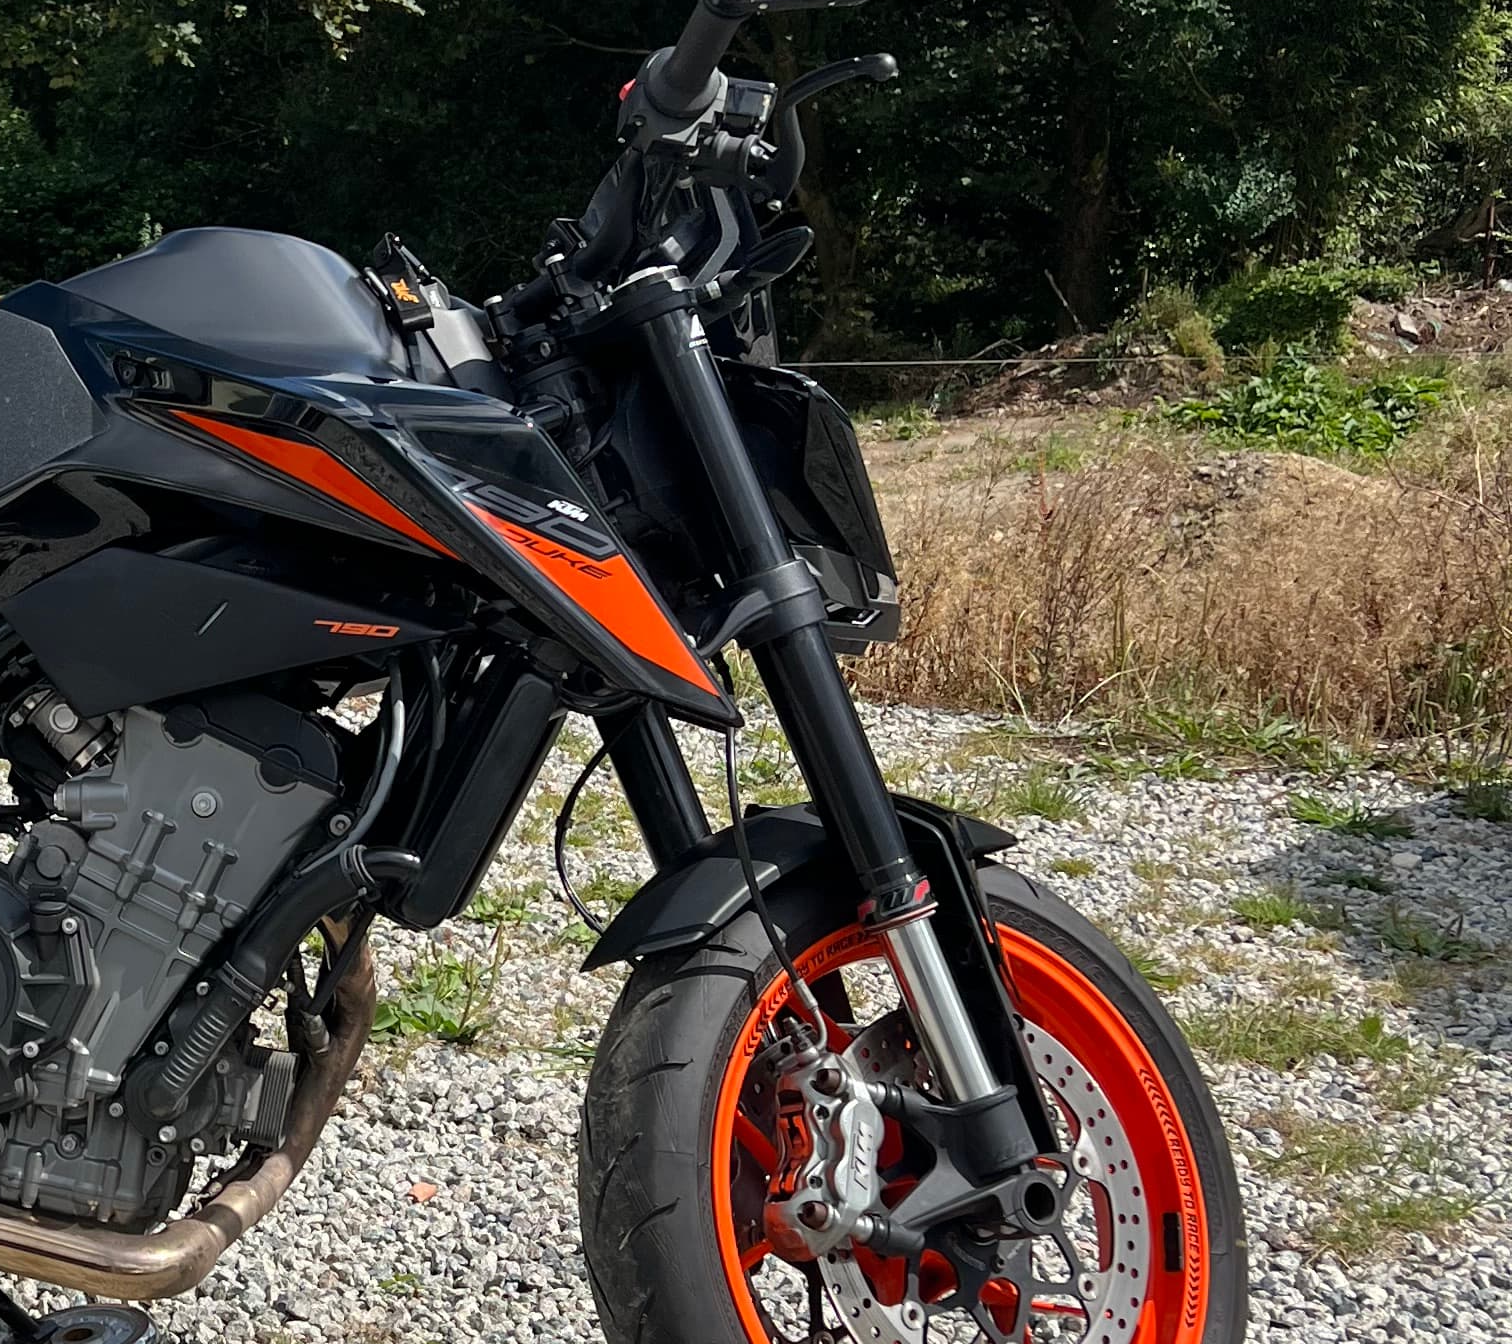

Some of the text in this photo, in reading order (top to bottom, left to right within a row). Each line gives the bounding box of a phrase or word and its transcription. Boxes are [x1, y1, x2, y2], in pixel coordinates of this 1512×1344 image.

[547, 499, 589, 522] KTM
[501, 527, 612, 579] DUKE
[313, 620, 400, 638] 790
[811, 951, 824, 967] TO
[1169, 1137, 1200, 1255] READY TO RACE
